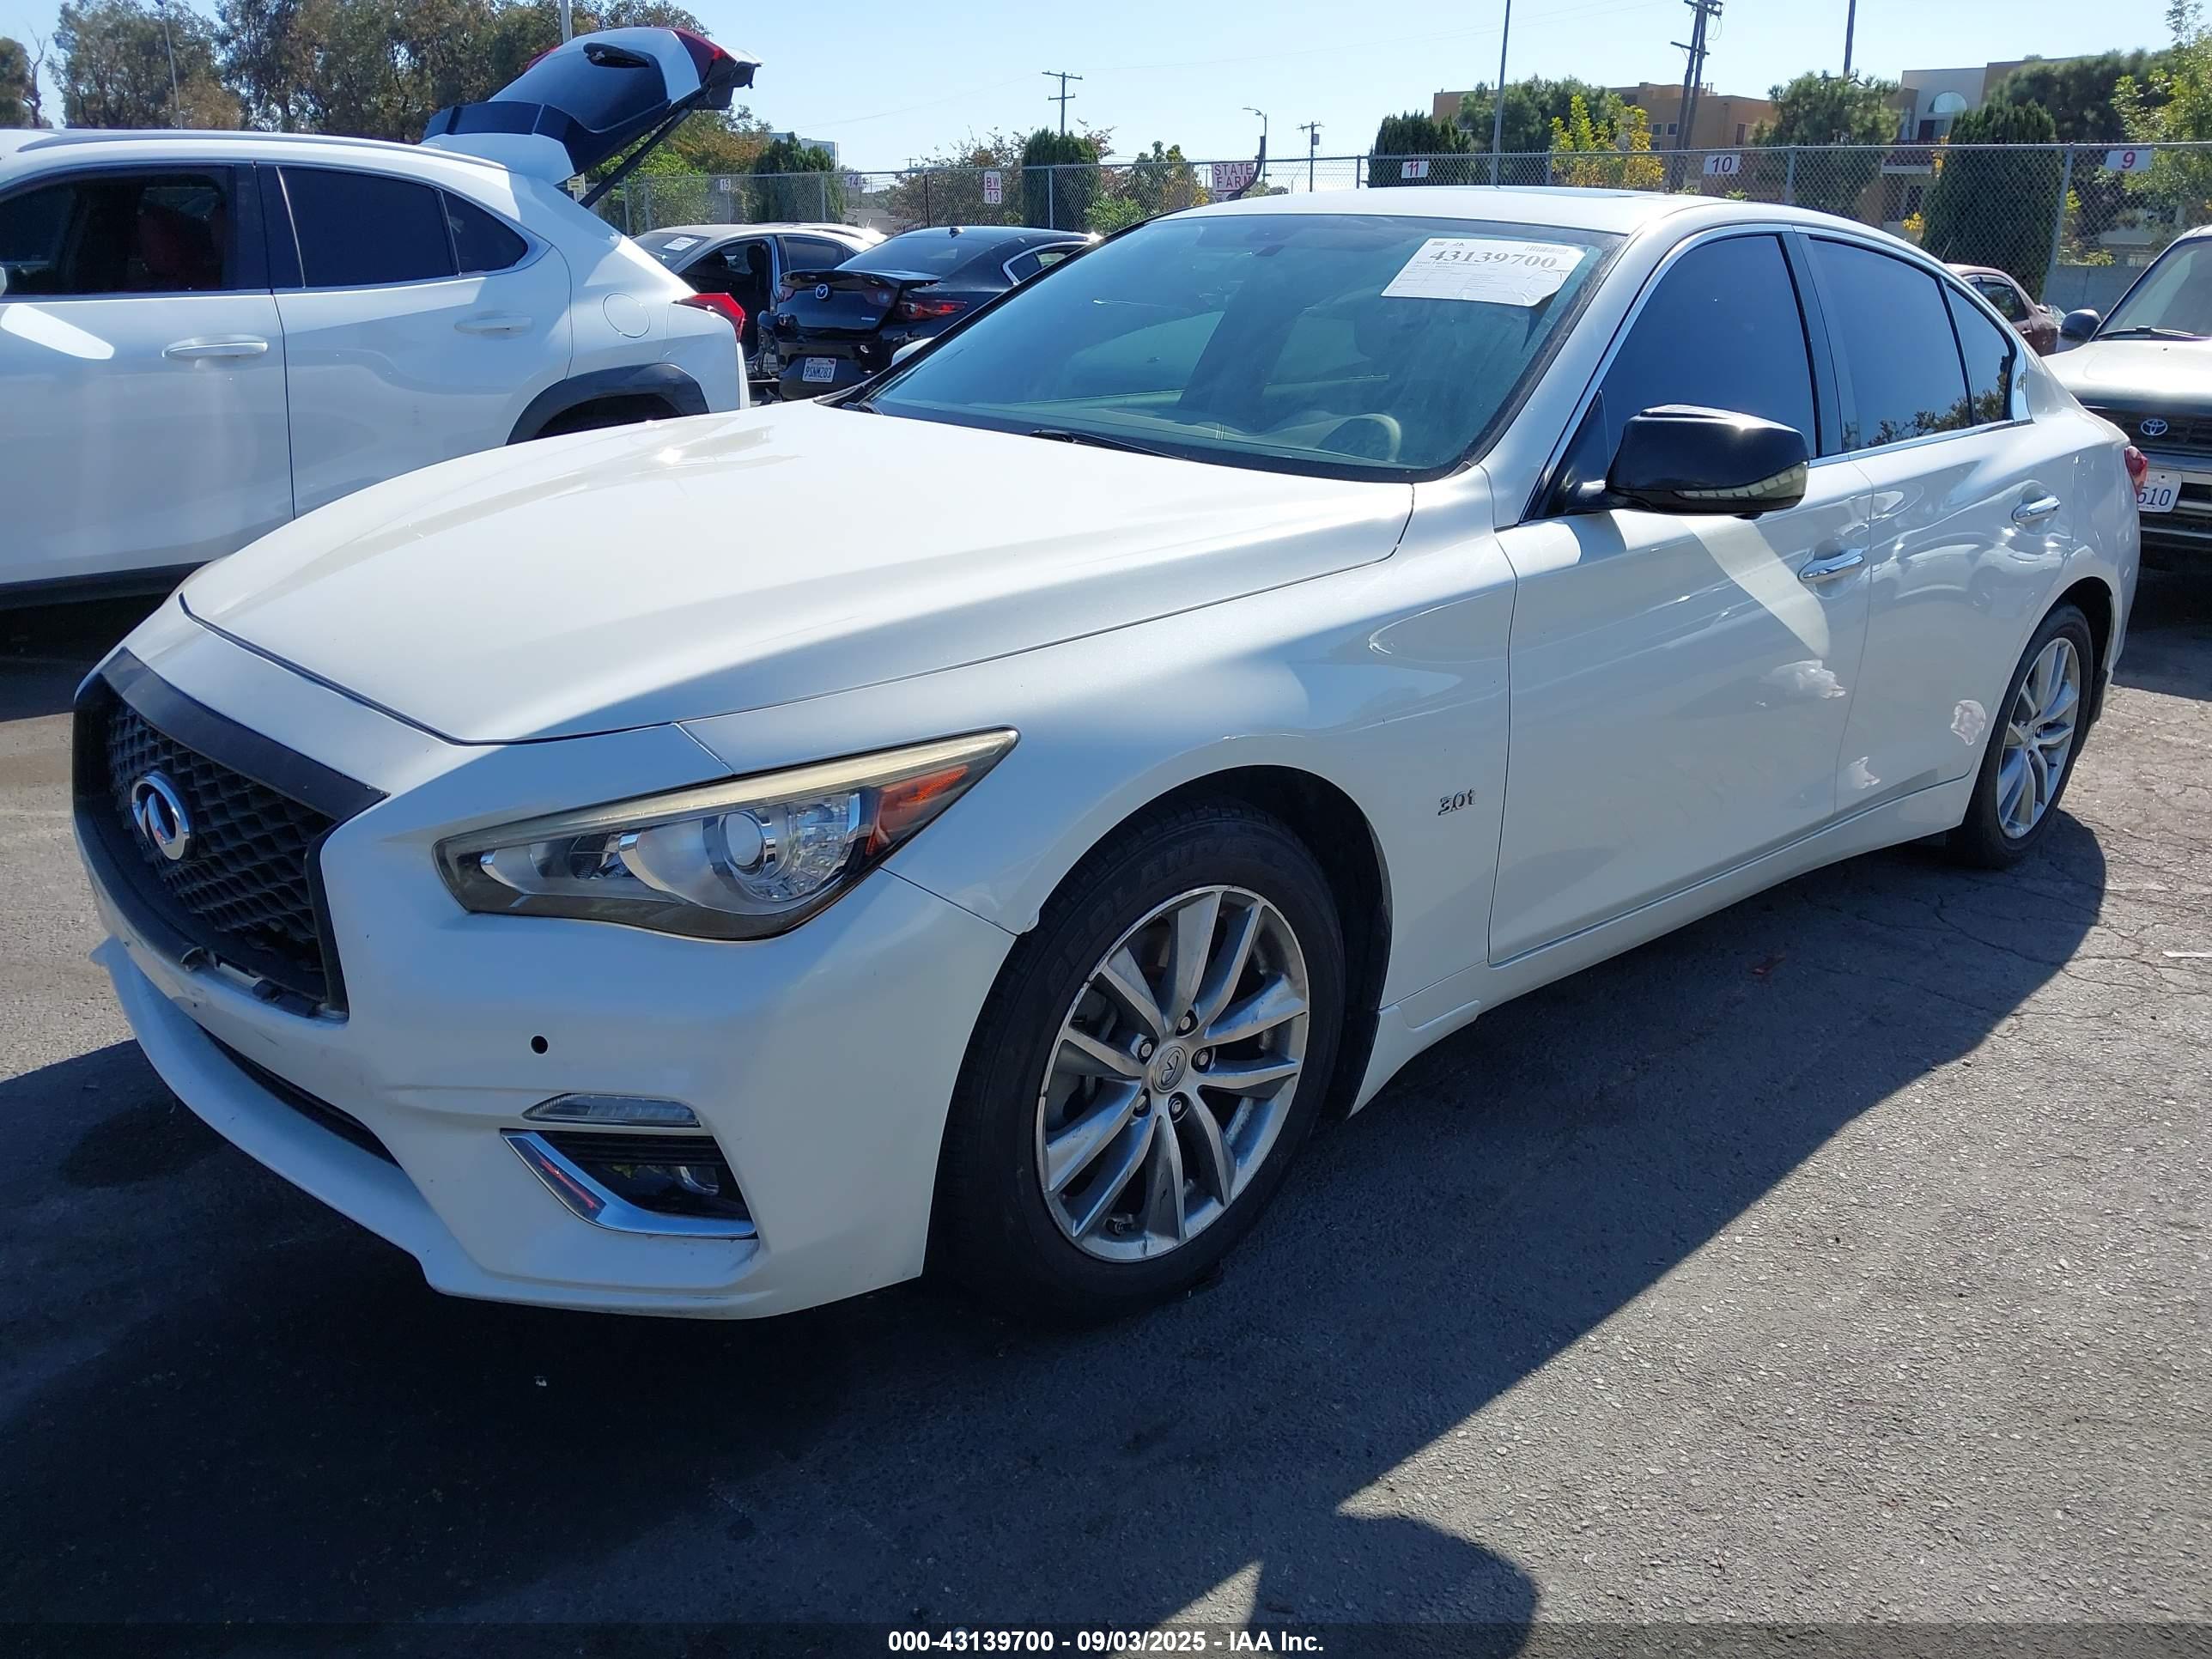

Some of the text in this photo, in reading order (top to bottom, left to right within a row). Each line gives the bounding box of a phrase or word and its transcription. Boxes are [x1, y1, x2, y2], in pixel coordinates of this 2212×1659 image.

[1712, 156, 1733, 173] 10
[2121, 151, 2136, 169] 9
[1214, 163, 1253, 176] STATE
[1407, 162, 1419, 177] 11
[721, 179, 730, 190] 15
[848, 176, 859, 187] 14
[986, 177, 1000, 187] BW
[988, 191, 1000, 203] 13
[1429, 249, 1558, 269] 43139700
